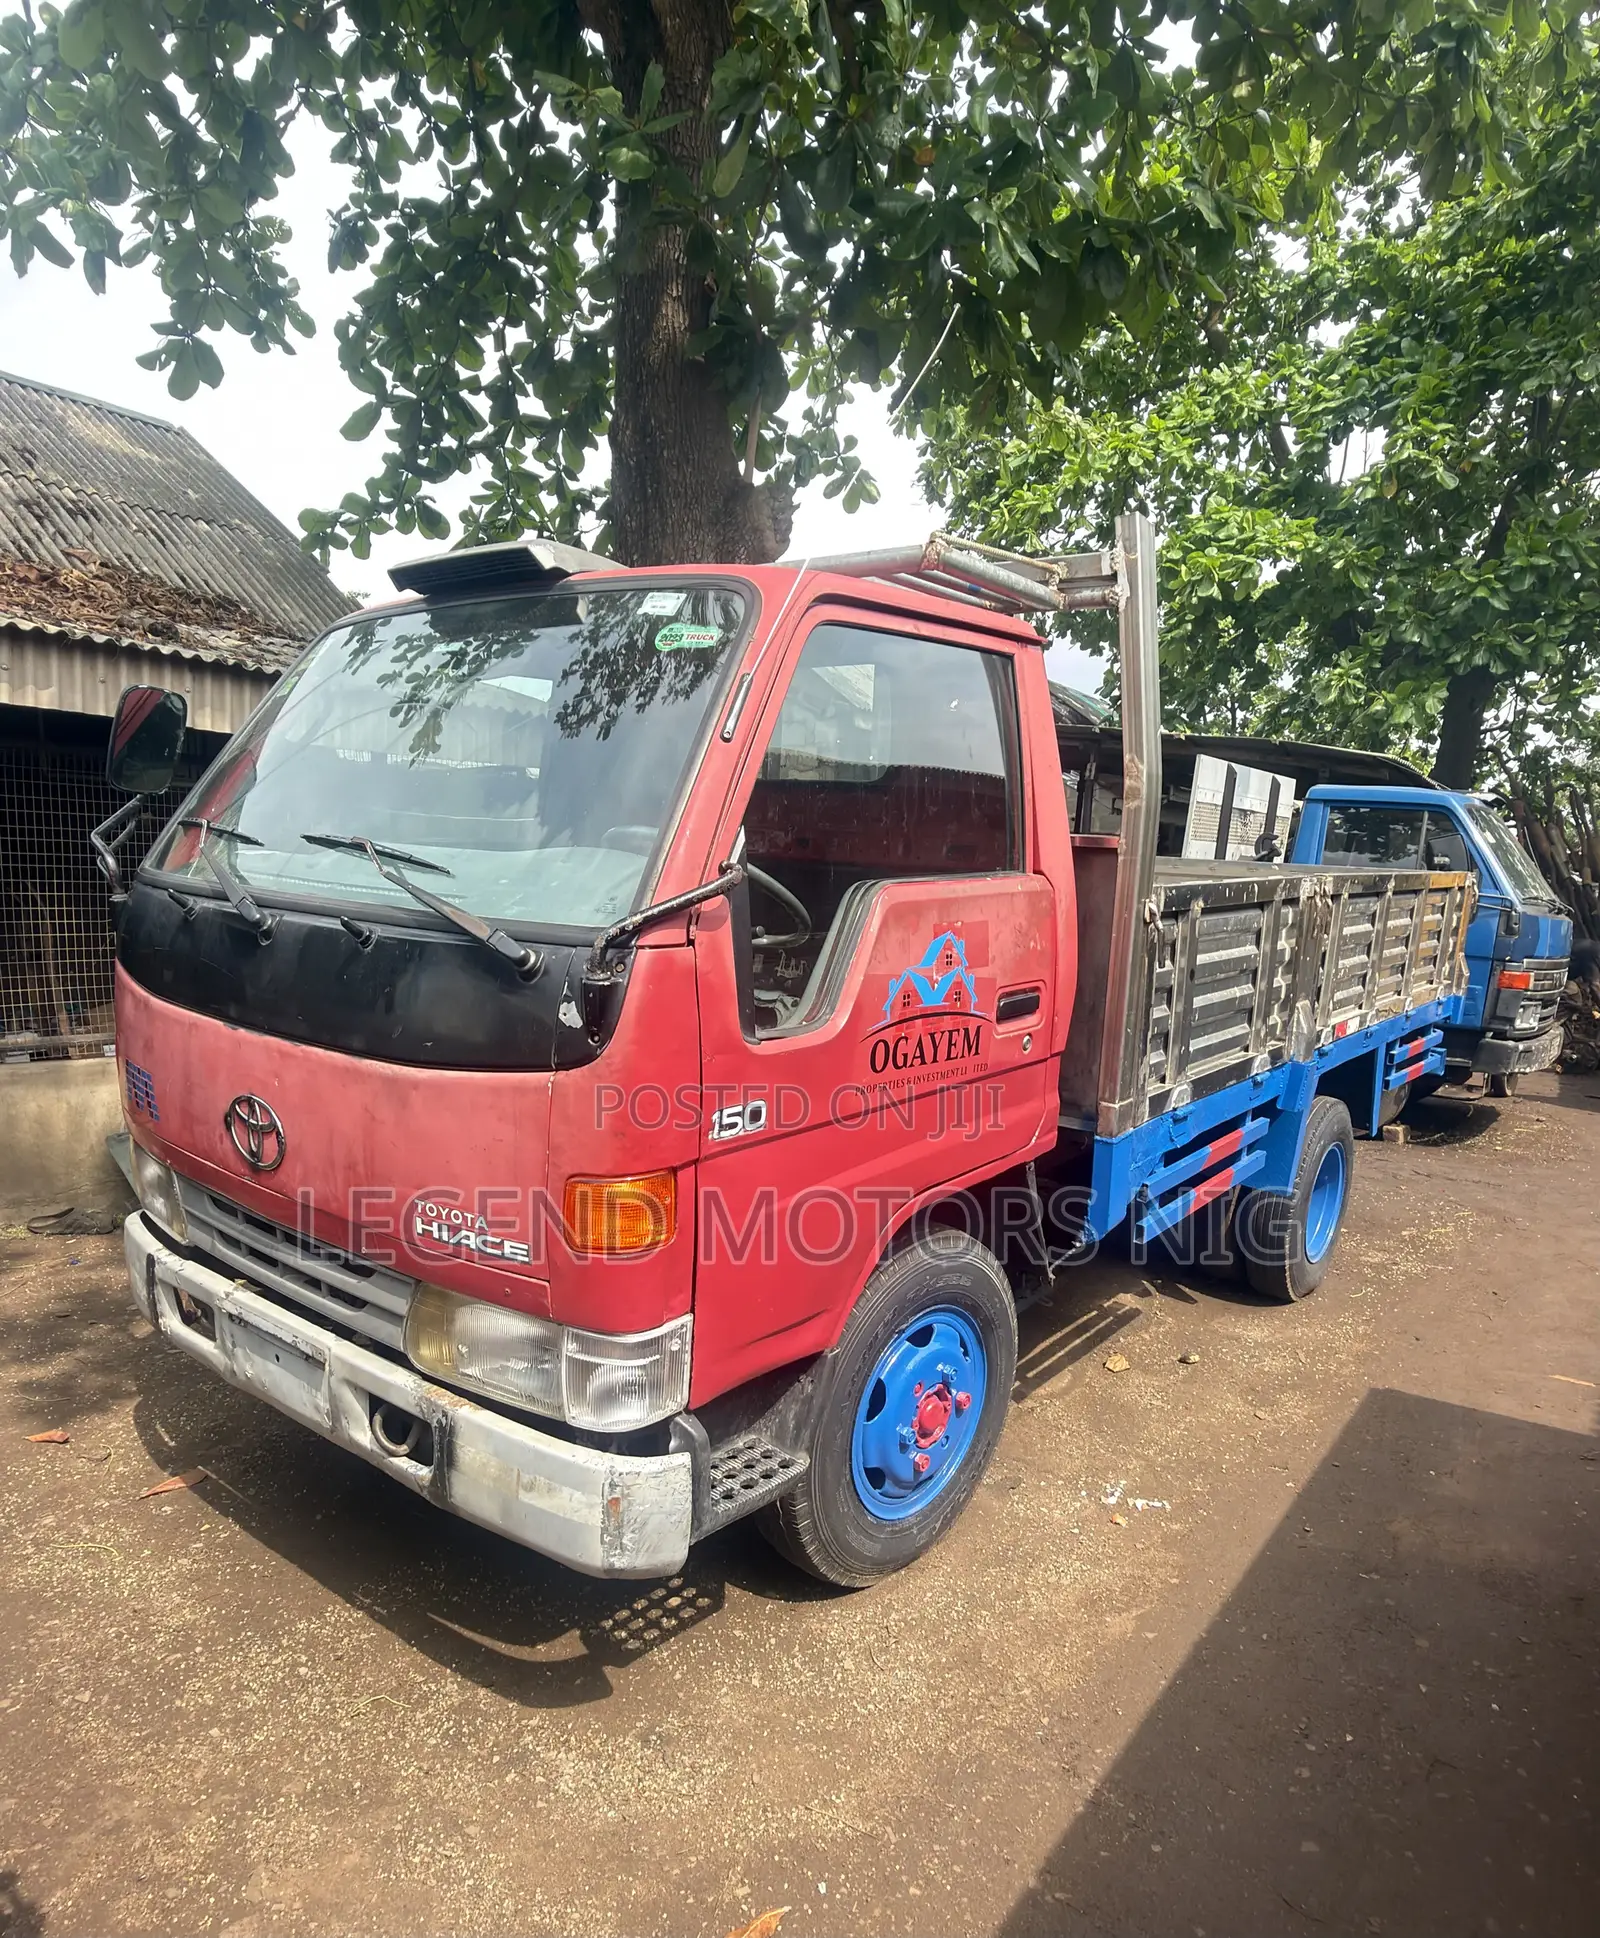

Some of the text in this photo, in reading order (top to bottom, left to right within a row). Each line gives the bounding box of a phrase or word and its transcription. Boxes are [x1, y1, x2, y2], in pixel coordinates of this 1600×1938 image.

[686, 633, 715, 641] TRUCK
[870, 1025, 982, 1074] OGAYEM
[855, 1078, 906, 1096] PROPERTIES
[913, 1067, 960, 1085] INVESTMENT
[710, 1099, 767, 1140] 150
[414, 1199, 489, 1231] TOYOTA
[415, 1217, 531, 1264] HIACE
